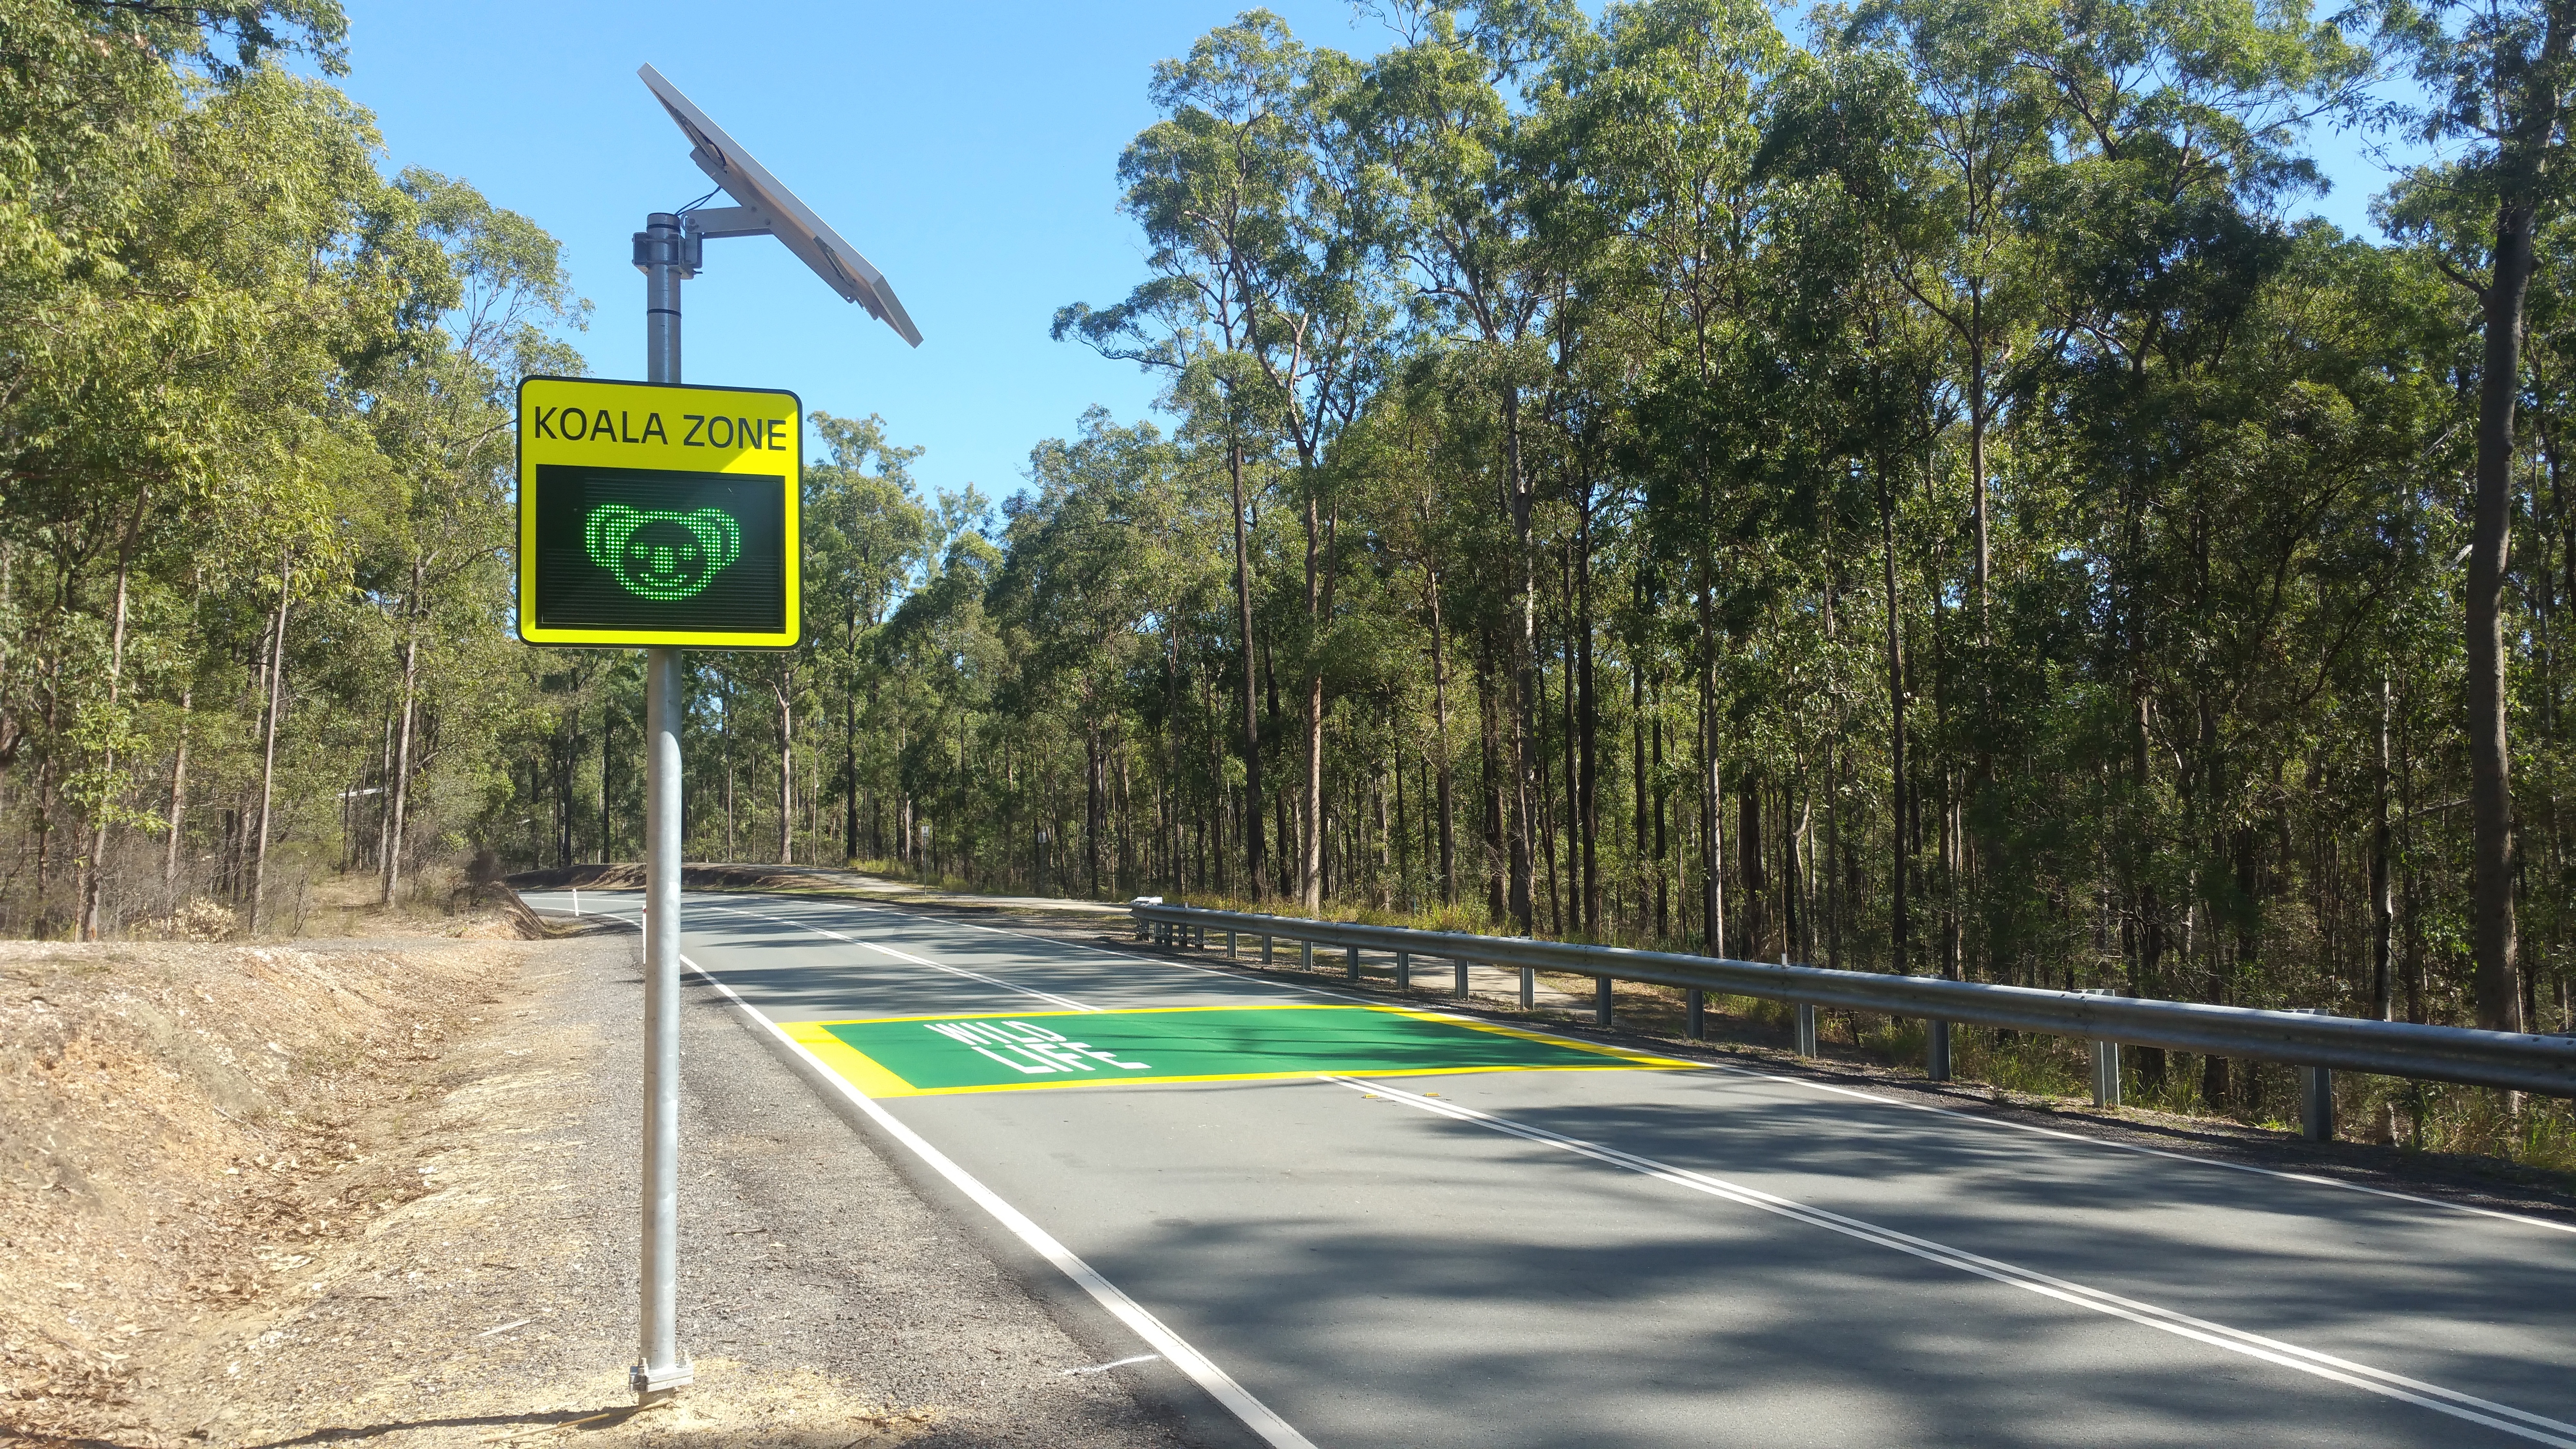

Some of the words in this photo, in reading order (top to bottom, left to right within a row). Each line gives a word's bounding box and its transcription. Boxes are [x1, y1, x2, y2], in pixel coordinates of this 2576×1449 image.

[535, 406, 668, 445] KOALA
[683, 414, 786, 450] ZONE
[923, 1021, 1067, 1046] WILD
[971, 1042, 1152, 1074] LIFE
